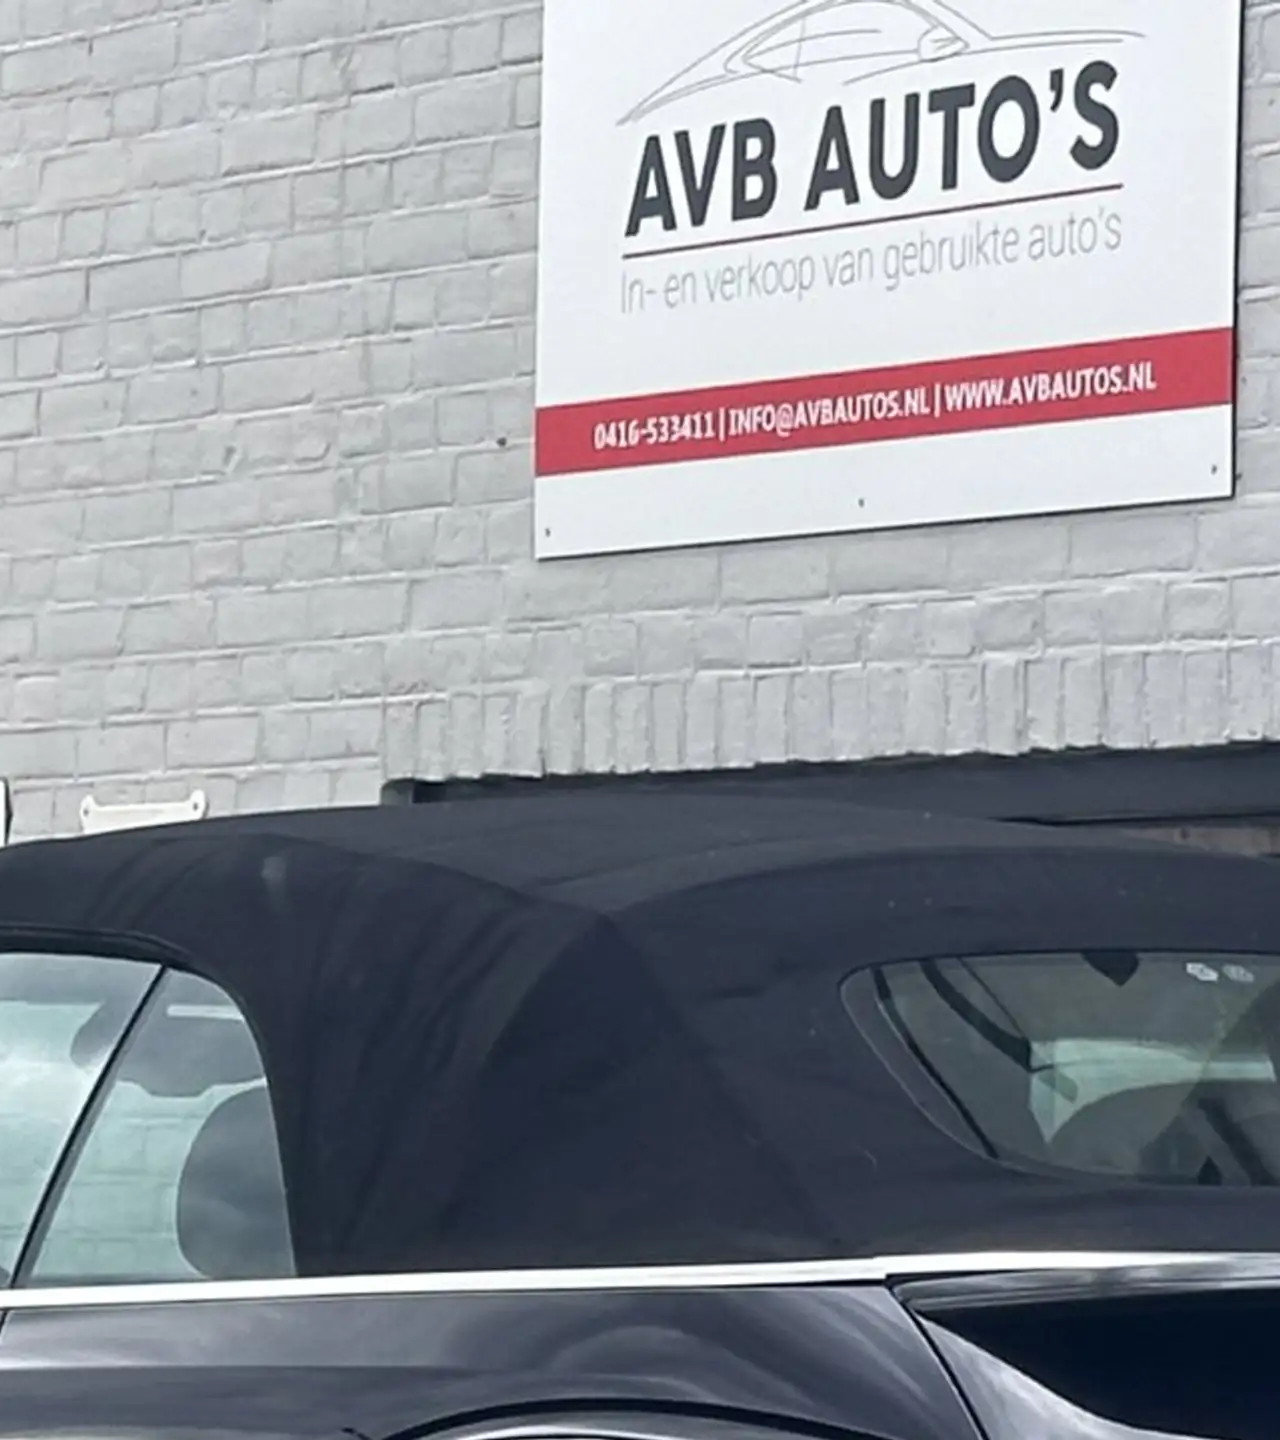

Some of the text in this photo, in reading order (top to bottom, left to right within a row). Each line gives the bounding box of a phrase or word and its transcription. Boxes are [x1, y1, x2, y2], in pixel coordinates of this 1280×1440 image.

[625, 60, 1121, 238] AVB AUTO'S
[621, 204, 1123, 314] In- en verkoop van gebruikte auto's
[593, 361, 1158, 450] 0416-533411 INFO@AVBAUTOS.NL WWW.AVBAUTOS.NL
